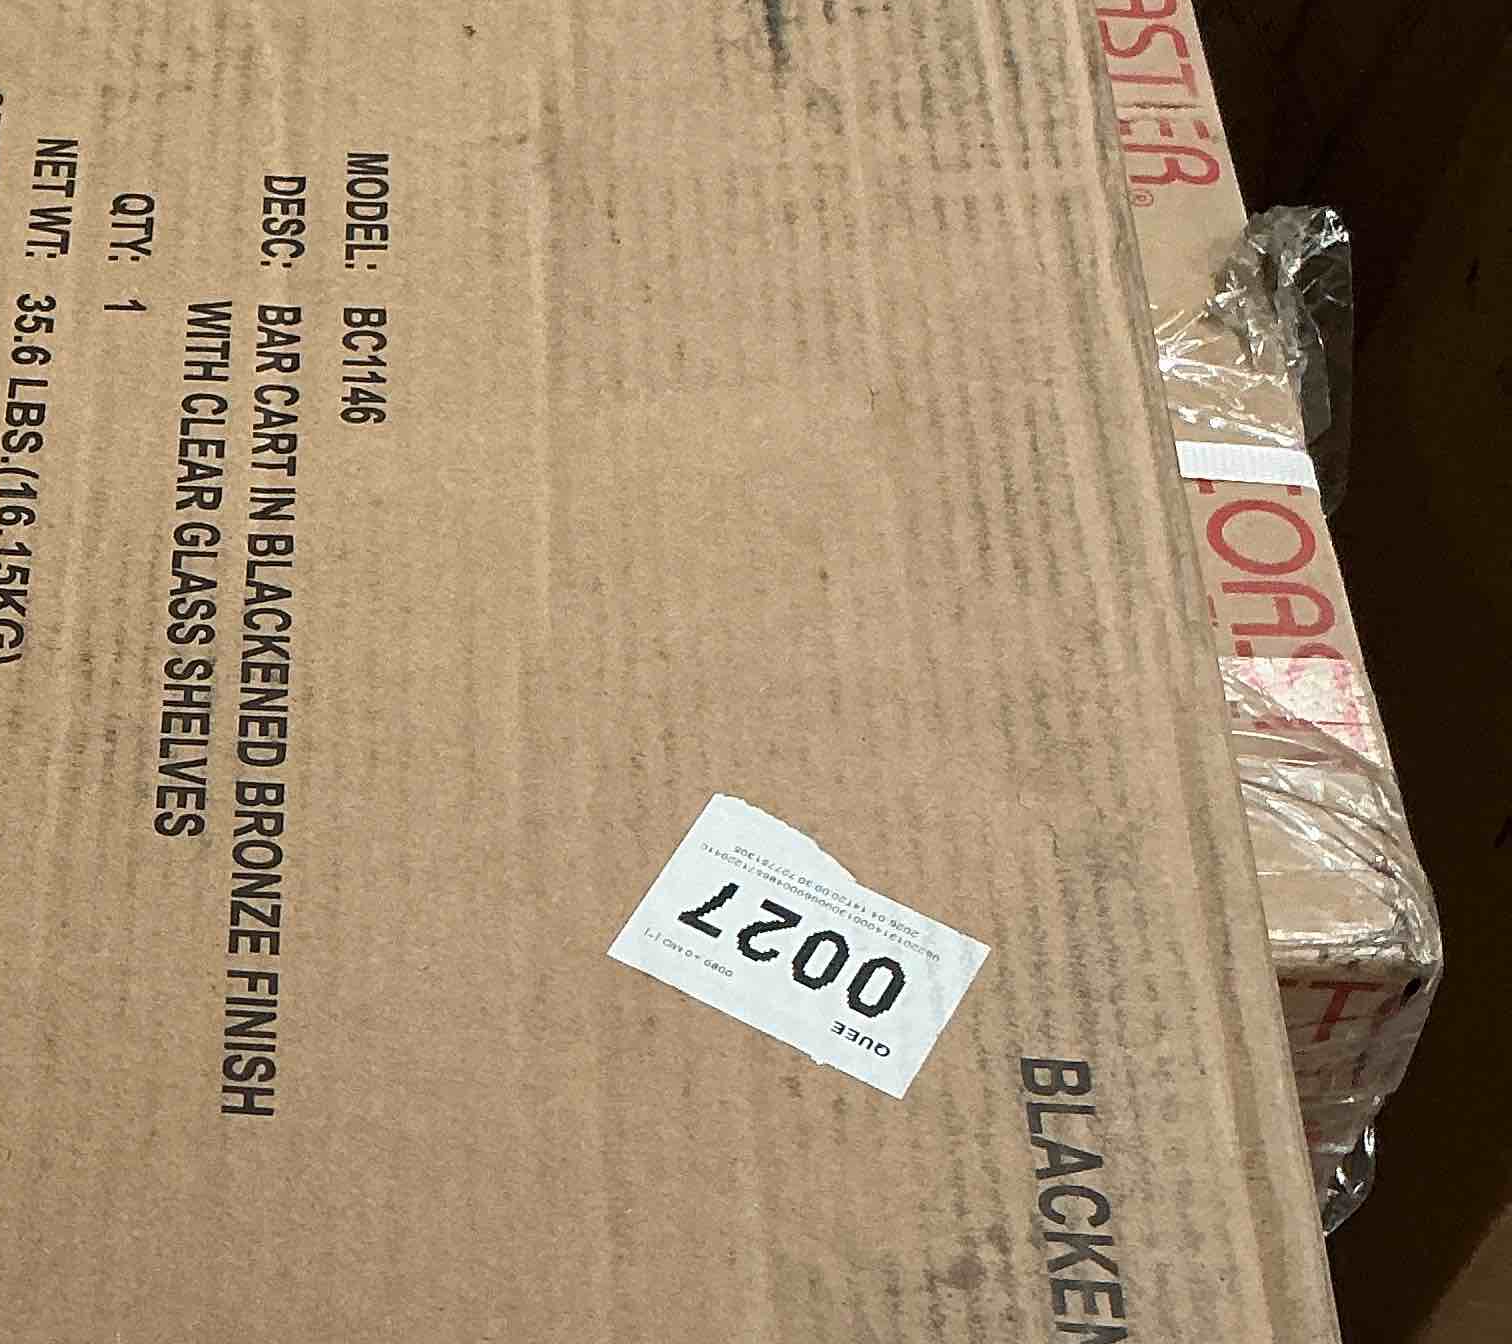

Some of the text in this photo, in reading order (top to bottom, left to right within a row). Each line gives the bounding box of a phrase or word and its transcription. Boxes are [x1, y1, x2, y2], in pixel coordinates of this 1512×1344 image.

[33, 136, 79, 199] NET
[24, 206, 75, 260] WT:
[103, 191, 157, 314] QTY: 1
[339, 151, 390, 427] MODEL: BC1146
[10, 292, 58, 367] 35.6
[154, 299, 234, 838] WITH CLEAR GLASS SHELVES
[220, 173, 307, 1118] DESC: BAR CART IN BLACKENED BRONZE FINISH
[677, 882, 906, 1019] 0027
[829, 1019, 892, 1059] QUEE
